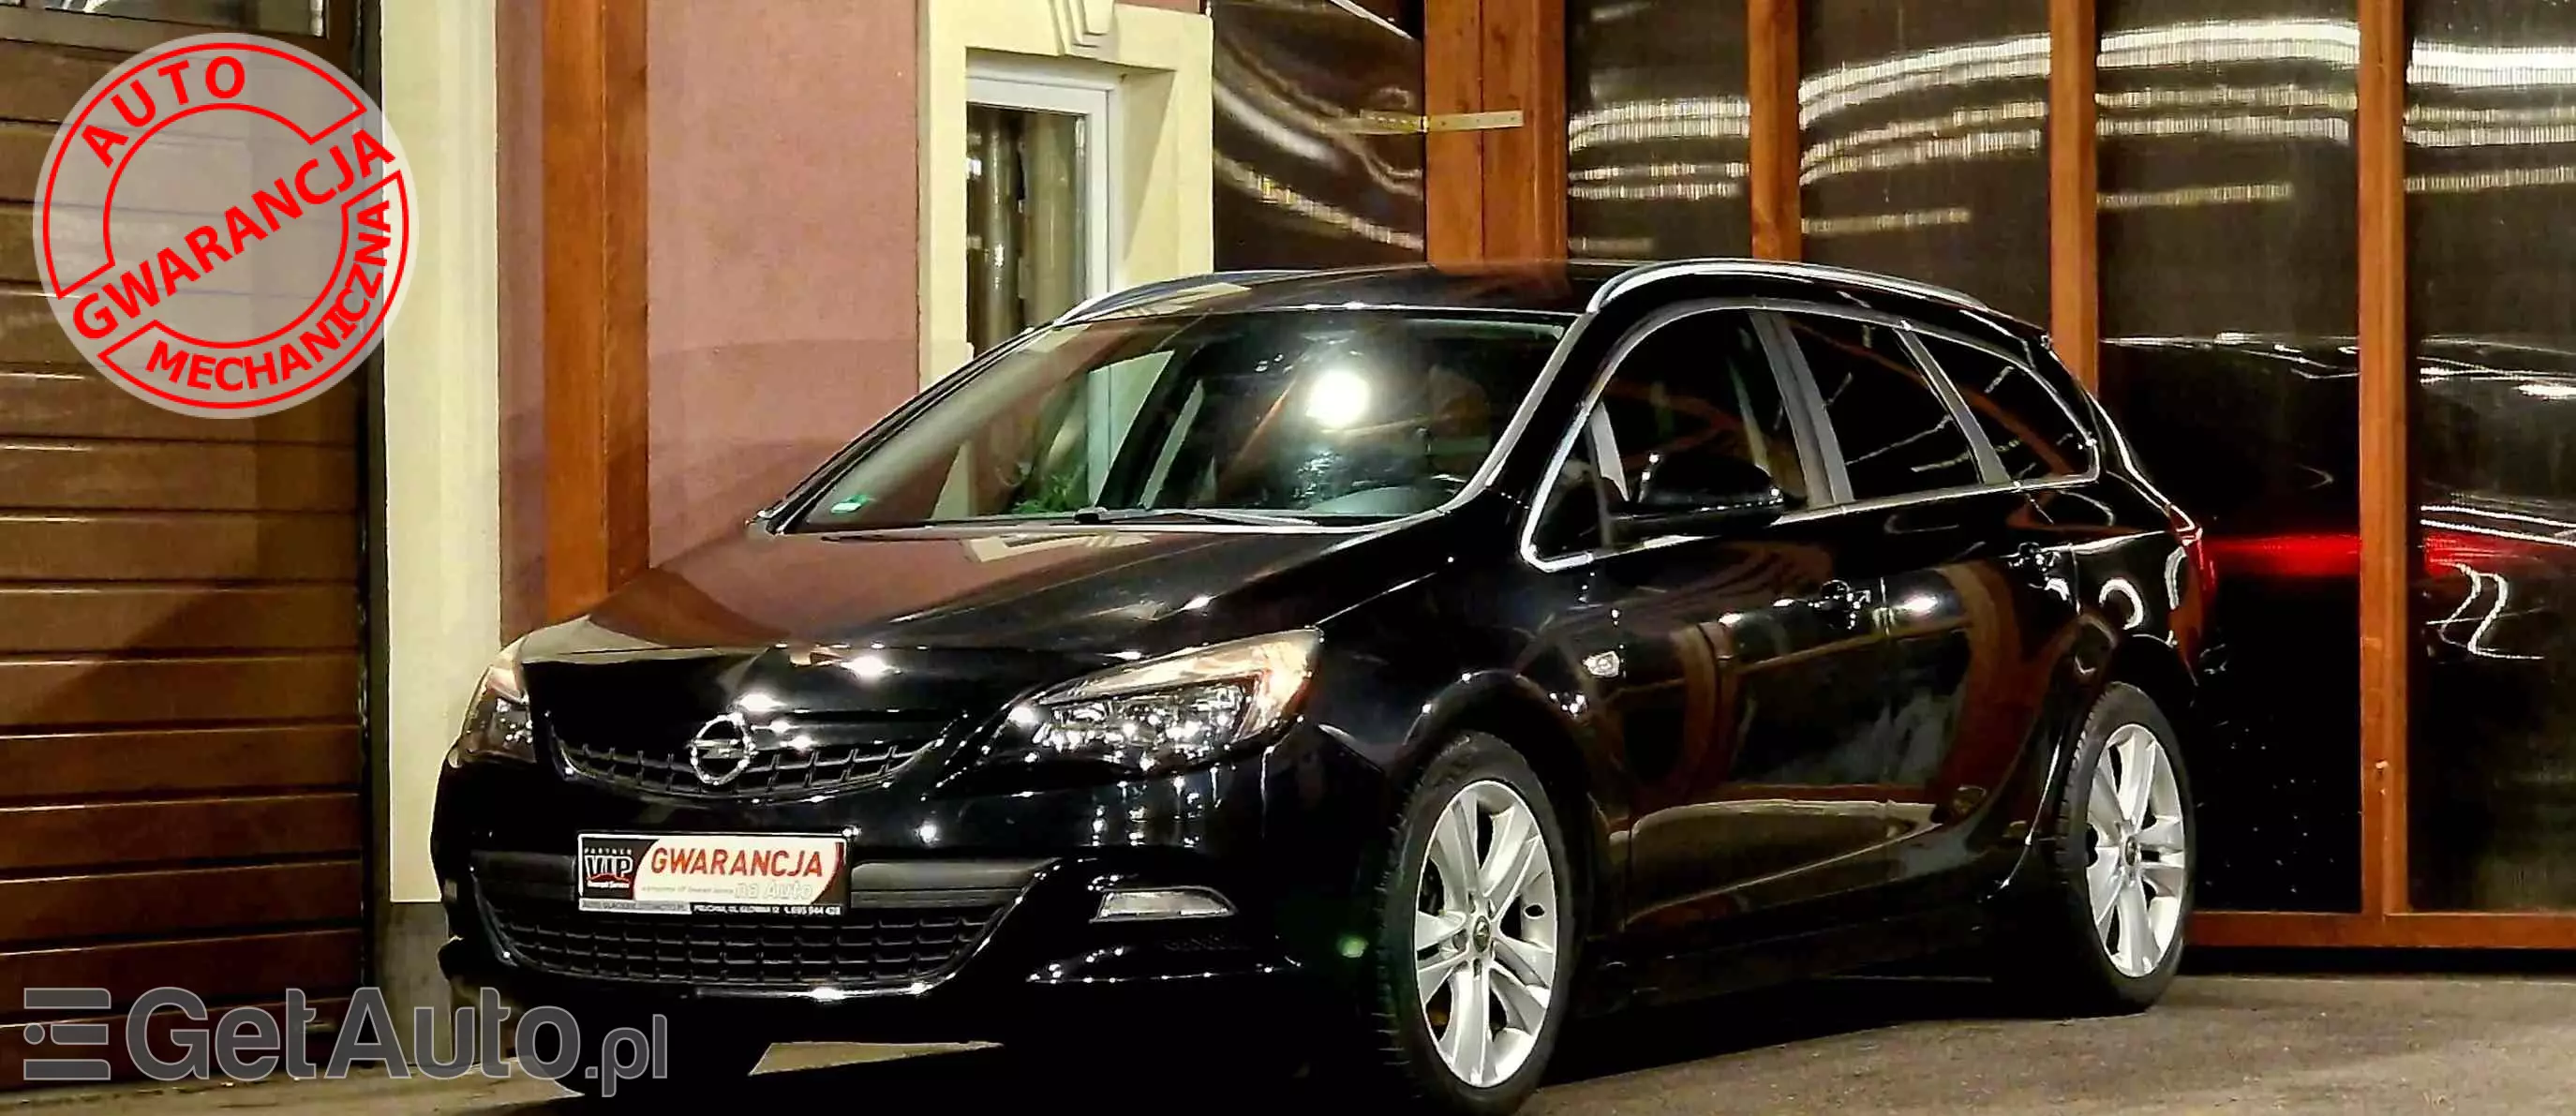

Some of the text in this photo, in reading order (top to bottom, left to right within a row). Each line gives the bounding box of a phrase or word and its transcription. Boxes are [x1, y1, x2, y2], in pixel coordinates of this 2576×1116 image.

[584, 855, 633, 878] VIP
[650, 847, 823, 877] GWARANCJA
[763, 879, 813, 900] Auto
